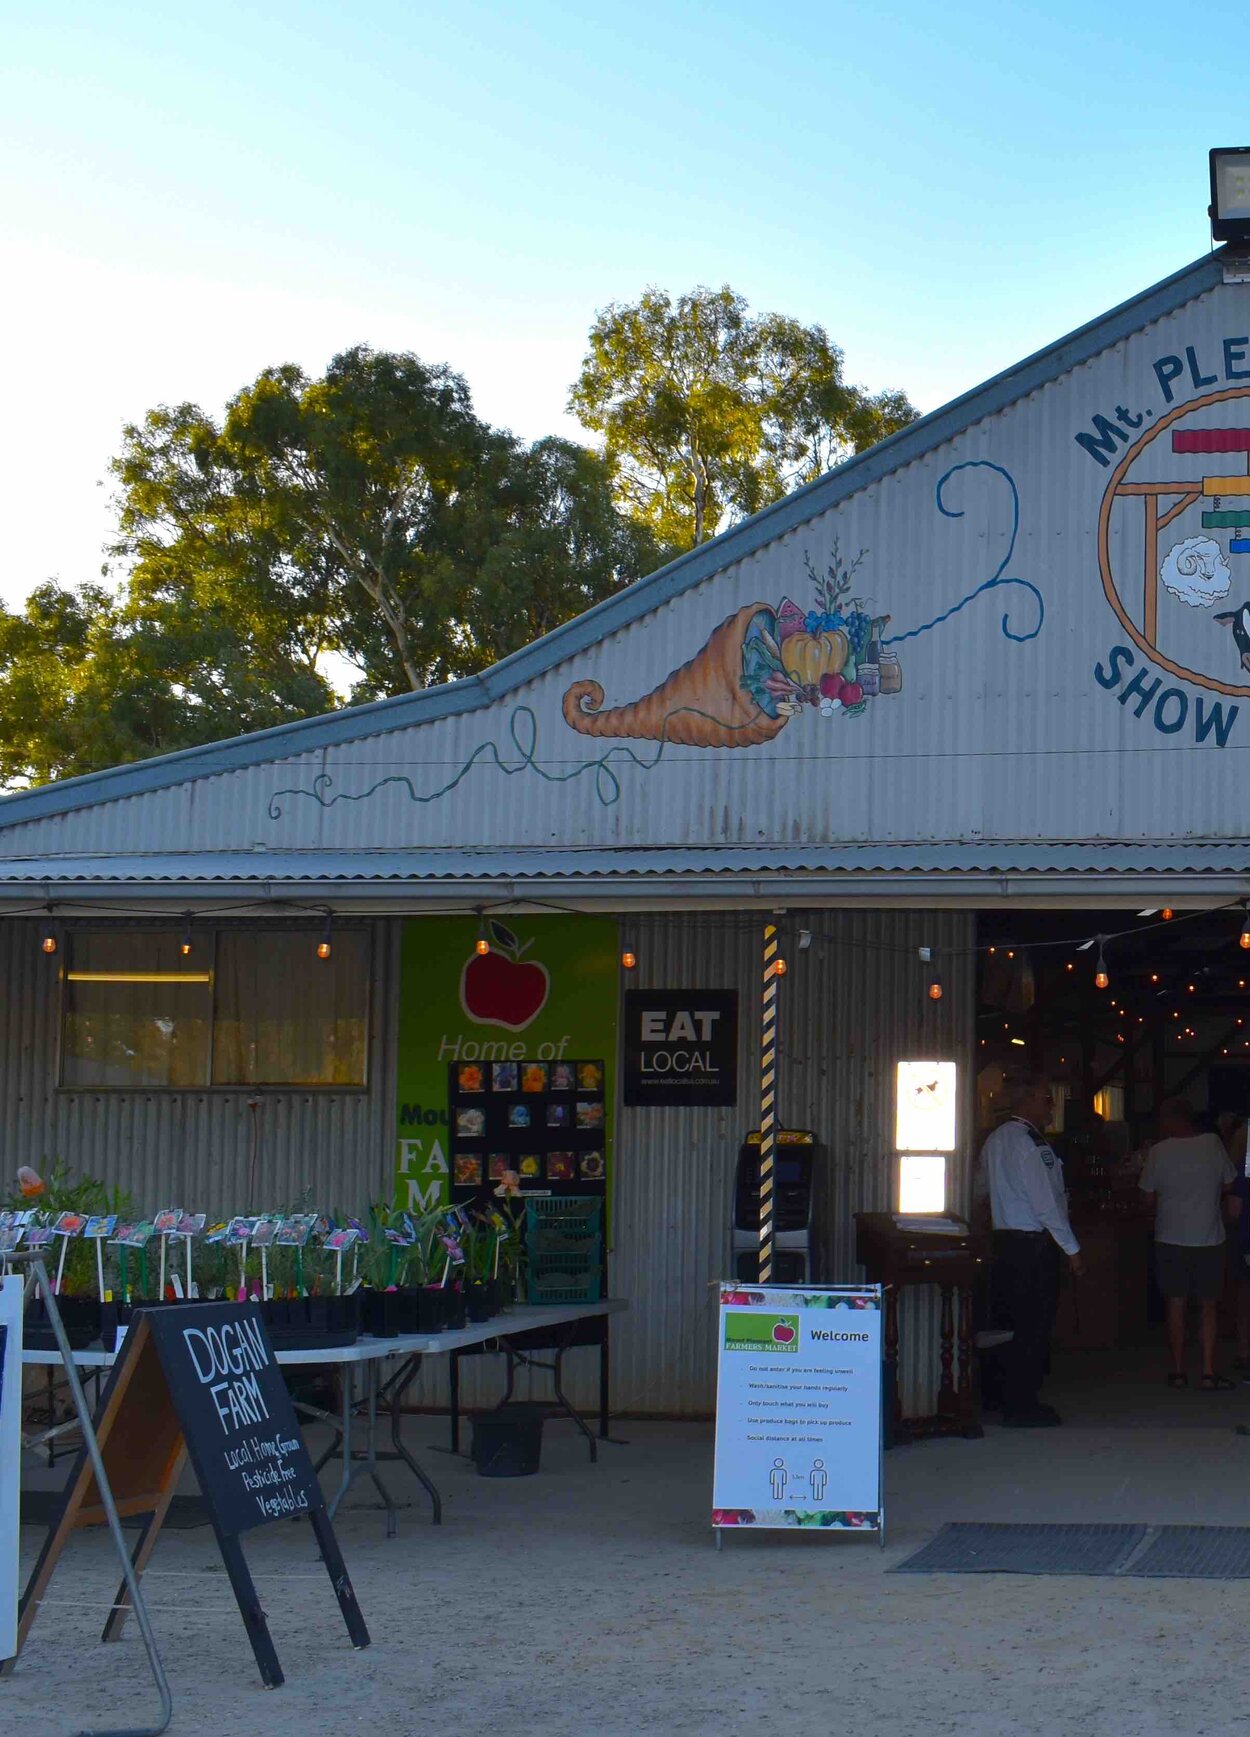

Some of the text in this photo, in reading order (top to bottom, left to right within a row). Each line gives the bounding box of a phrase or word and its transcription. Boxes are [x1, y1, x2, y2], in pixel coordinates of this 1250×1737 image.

[1074, 405, 1153, 468] Mt.
[1094, 645, 1239, 747] SHOW
[641, 1011, 720, 1041] EAT
[437, 1034, 571, 1061] Home of
[641, 1051, 719, 1072] LOCAL
[183, 1317, 270, 1384] DOGAN
[726, 1342, 797, 1352] FARMERS MARKET
[810, 1330, 870, 1343] Welcome
[210, 1372, 270, 1435] FARM
[242, 1459, 296, 1491] Pesticide Free
[256, 1484, 308, 1517] Vegetables
